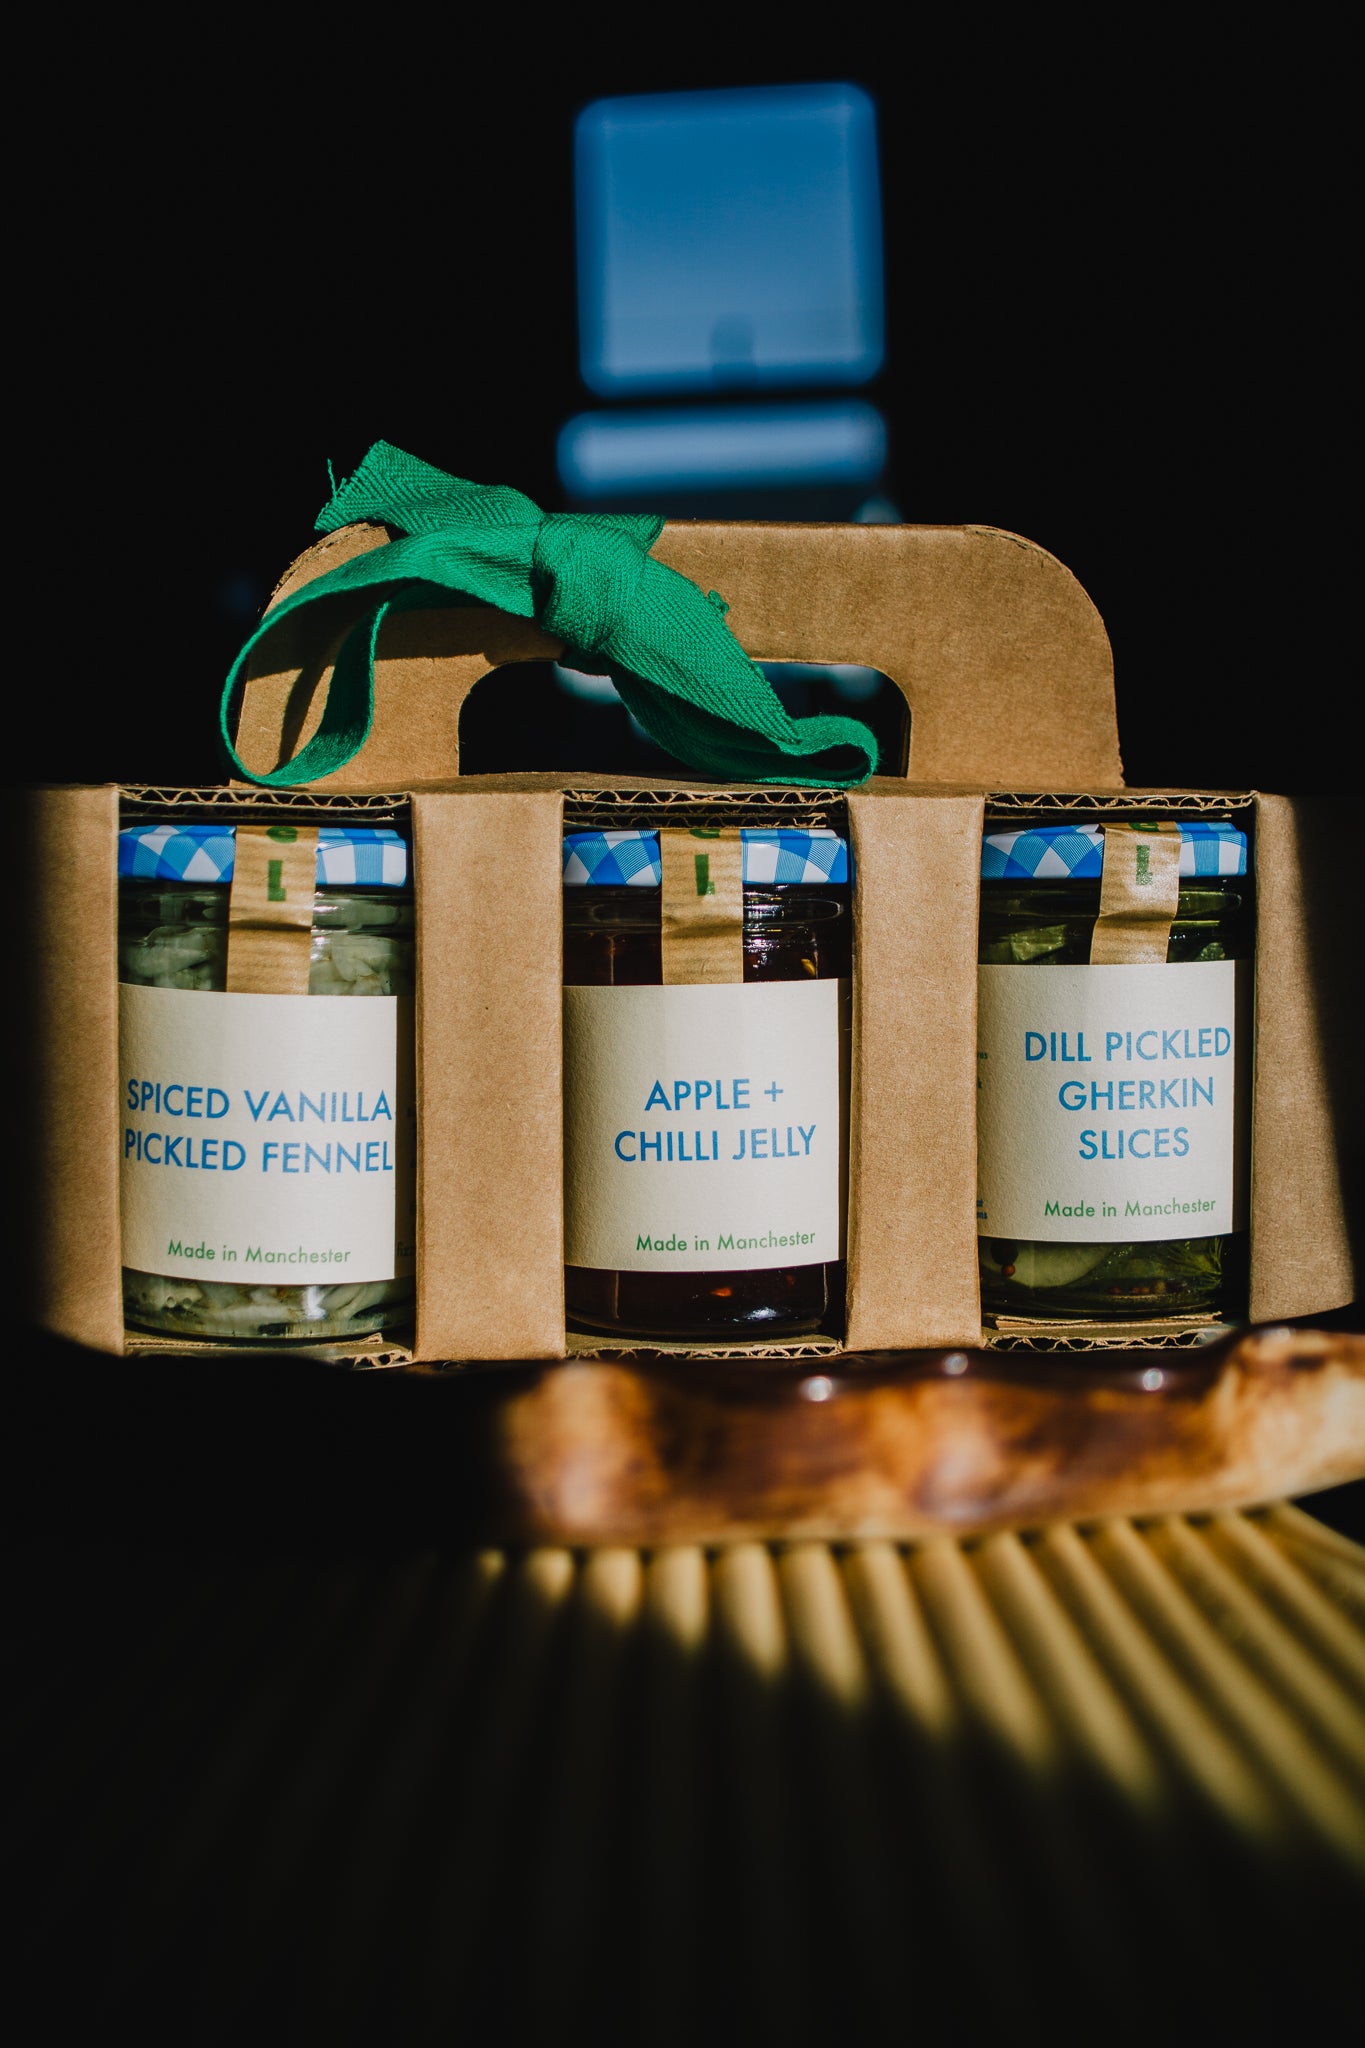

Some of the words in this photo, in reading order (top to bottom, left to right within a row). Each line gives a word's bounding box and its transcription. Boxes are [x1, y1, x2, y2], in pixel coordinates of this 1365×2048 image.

[1025, 1031, 1092, 1063] DILL
[1105, 1027, 1231, 1062] PICKLED
[127, 1078, 230, 1120] SPICED
[243, 1089, 392, 1122] VANILLA
[644, 1078, 750, 1112] APPLE
[764, 1082, 784, 1102] +
[1058, 1077, 1214, 1112] GHERKIN
[124, 1128, 247, 1172] PICKLED
[262, 1141, 393, 1174] FENNEL
[614, 1130, 719, 1162] CHILLI
[732, 1124, 817, 1161] JELLY
[1078, 1127, 1190, 1161] SLICES
[1044, 1200, 1095, 1218] Made
[1102, 1201, 1117, 1217] in
[1123, 1197, 1217, 1217] Manchester
[167, 1240, 216, 1261] Made
[222, 1244, 238, 1263] in
[244, 1246, 351, 1265] Manchester
[636, 1234, 687, 1252] Made
[694, 1235, 710, 1251] in
[717, 1230, 816, 1251] Manchester
